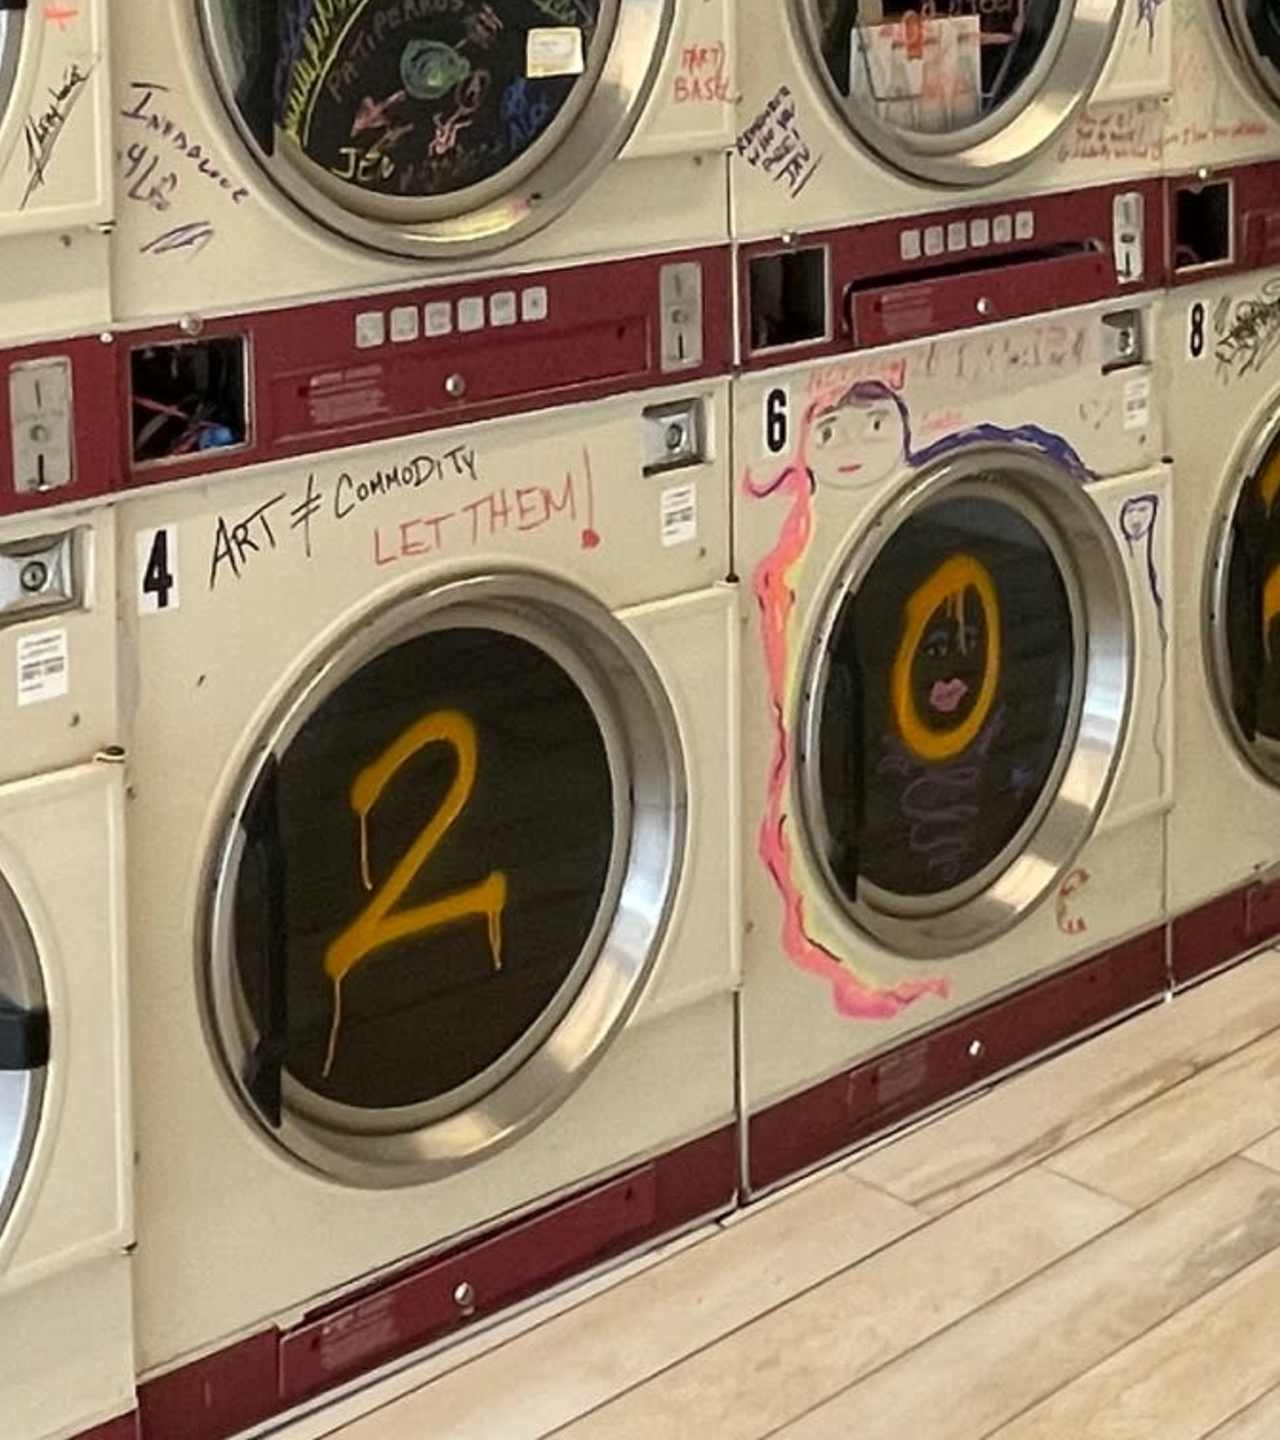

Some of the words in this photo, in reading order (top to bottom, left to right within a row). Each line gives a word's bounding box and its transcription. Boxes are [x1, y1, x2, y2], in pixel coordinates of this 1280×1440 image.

[1189, 302, 1206, 358] 8
[766, 388, 788, 452] 6
[208, 490, 287, 590] ART
[332, 444, 480, 521] COMMODITY
[372, 512, 457, 568] LET
[142, 528, 174, 609] 4
[322, 708, 508, 980] 2
